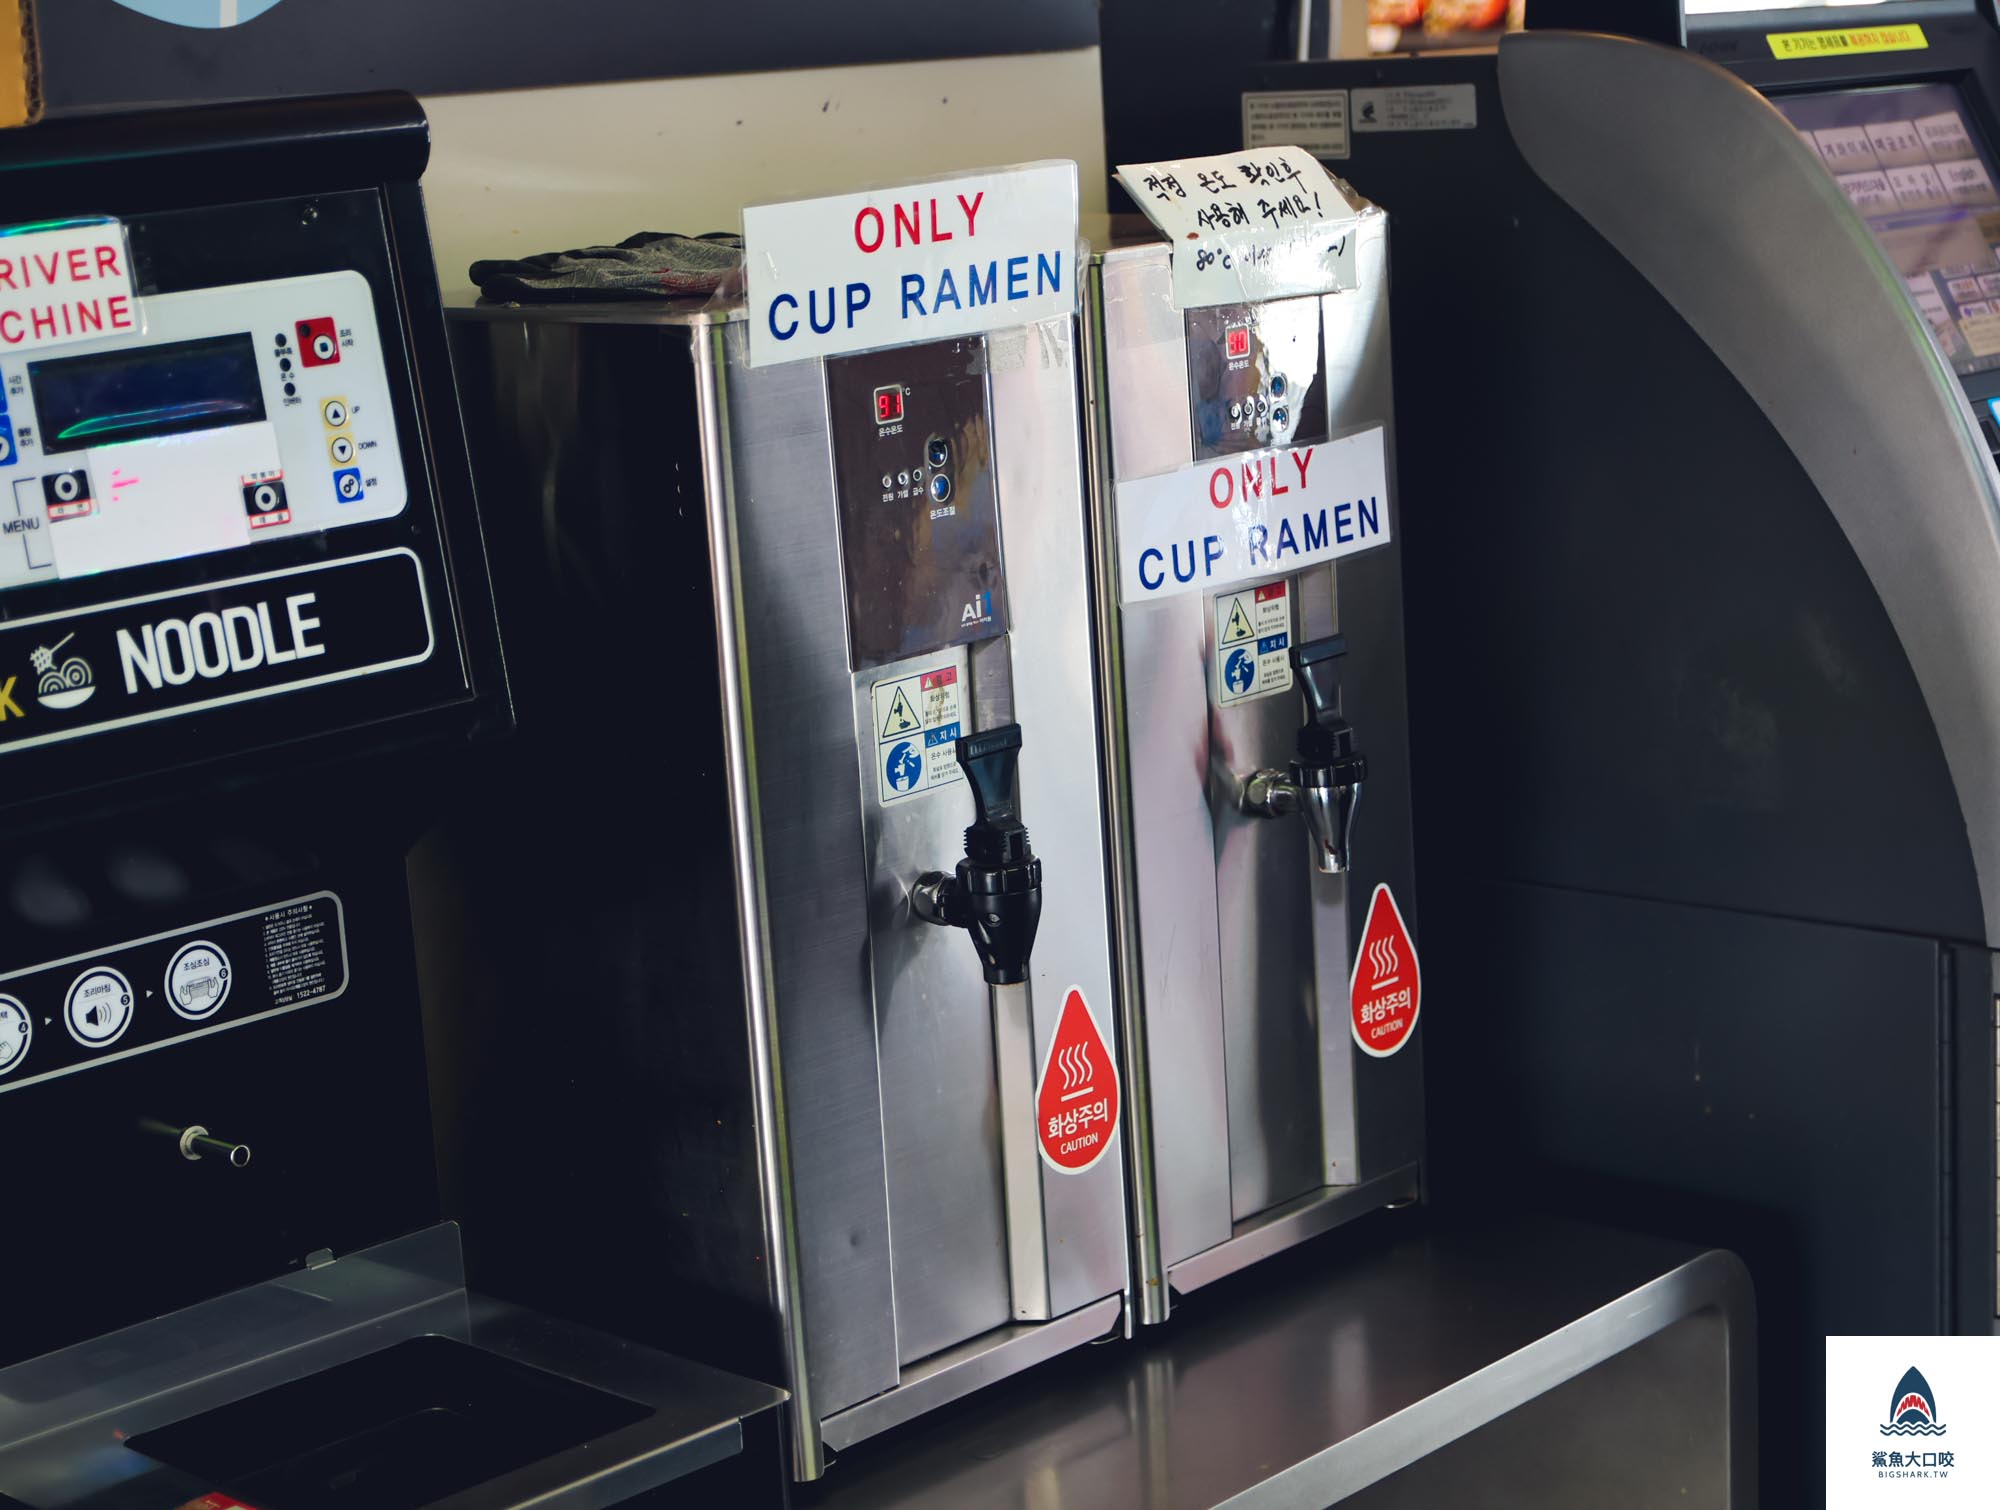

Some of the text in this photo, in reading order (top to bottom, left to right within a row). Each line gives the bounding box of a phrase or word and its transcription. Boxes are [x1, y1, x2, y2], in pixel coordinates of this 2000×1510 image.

[1143, 174, 1187, 202] 적정
[1197, 170, 1237, 194] 온도
[854, 192, 984, 254] ONLY
[1198, 192, 1324, 230] 사용해 주세요!
[0, 245, 121, 292] RIVER
[768, 251, 1061, 341] CUP RAMEN
[0, 296, 131, 344] CHINE
[878, 393, 903, 419] 91
[1209, 448, 1314, 509] ONLY
[3, 516, 40, 535] MENU
[1138, 496, 1380, 590] CUP RAMEN
[116, 592, 326, 695] NOODLE
[1360, 987, 1411, 1024] 화상주의
[1371, 1018, 1403, 1039] CAUTION
[1048, 1098, 1108, 1139] 화상주의
[1060, 1132, 1098, 1155] CAUTION
